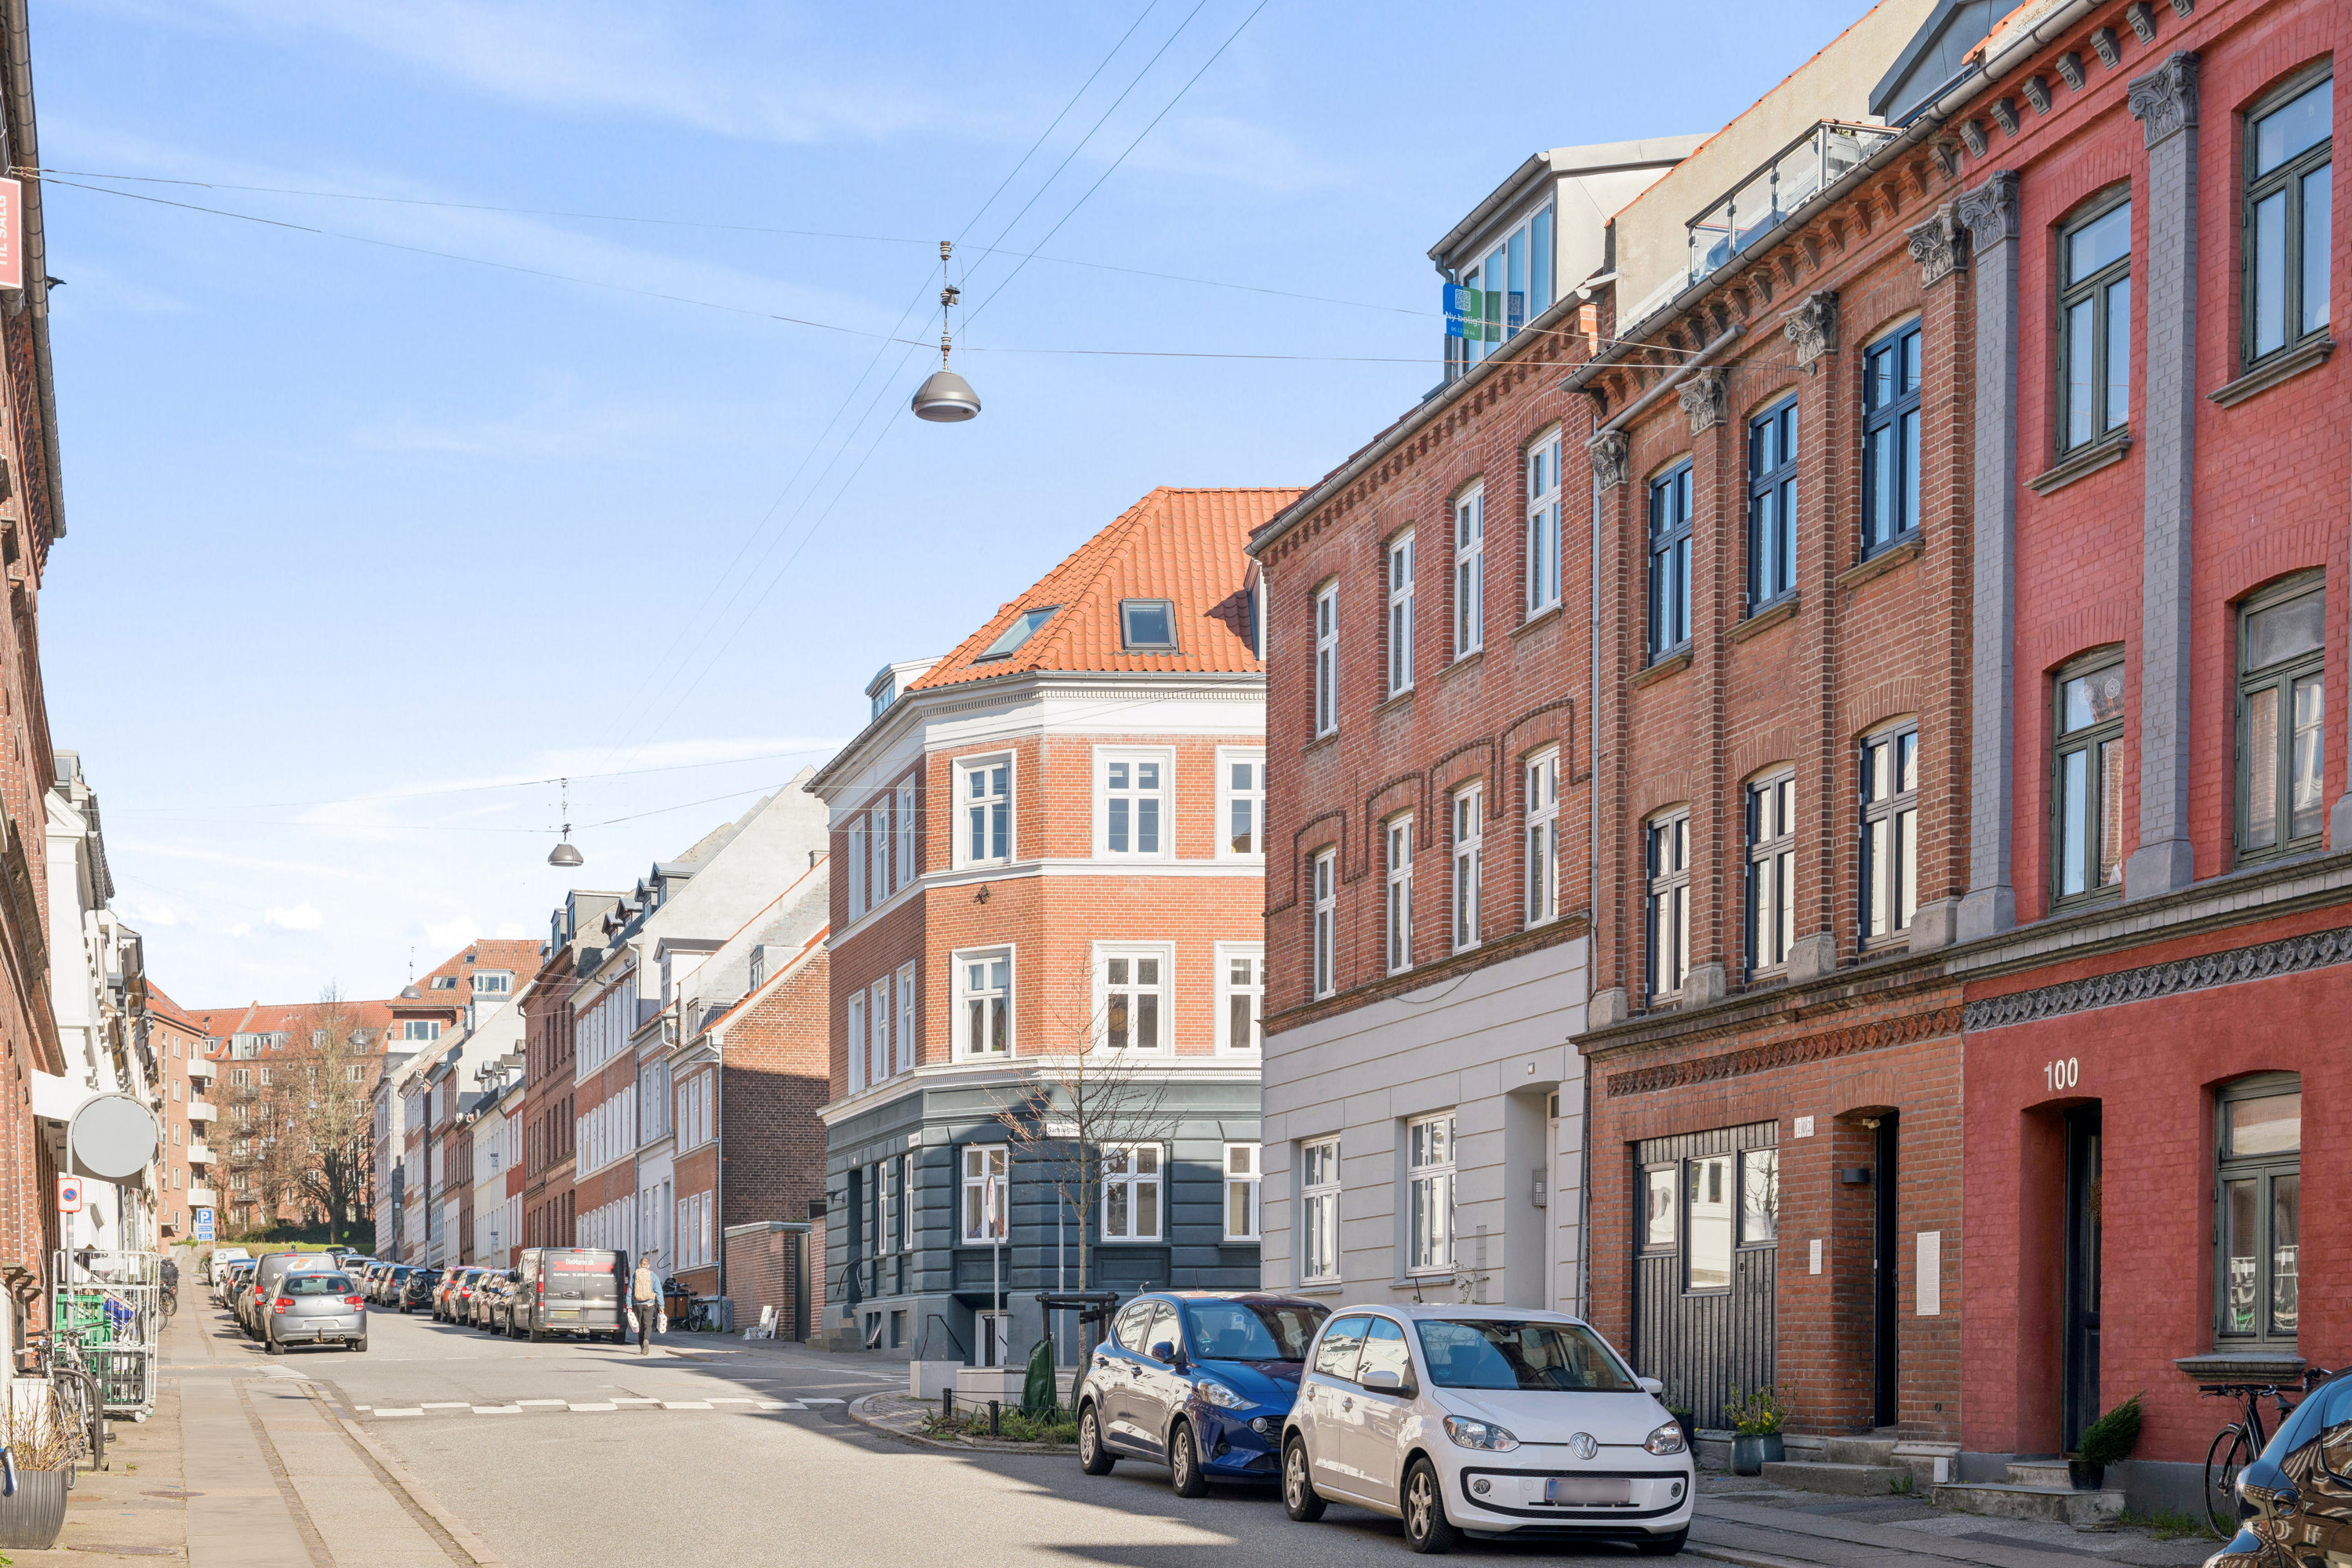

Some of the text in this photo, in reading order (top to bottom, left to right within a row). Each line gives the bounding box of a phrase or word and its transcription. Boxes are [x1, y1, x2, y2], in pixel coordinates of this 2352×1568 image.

[1445, 310, 1456, 322] Ny
[1457, 314, 1481, 327] bolig?
[2044, 1057, 2078, 1091] 100
[1798, 1120, 1812, 1134] 102
[200, 1211, 209, 1223] P
